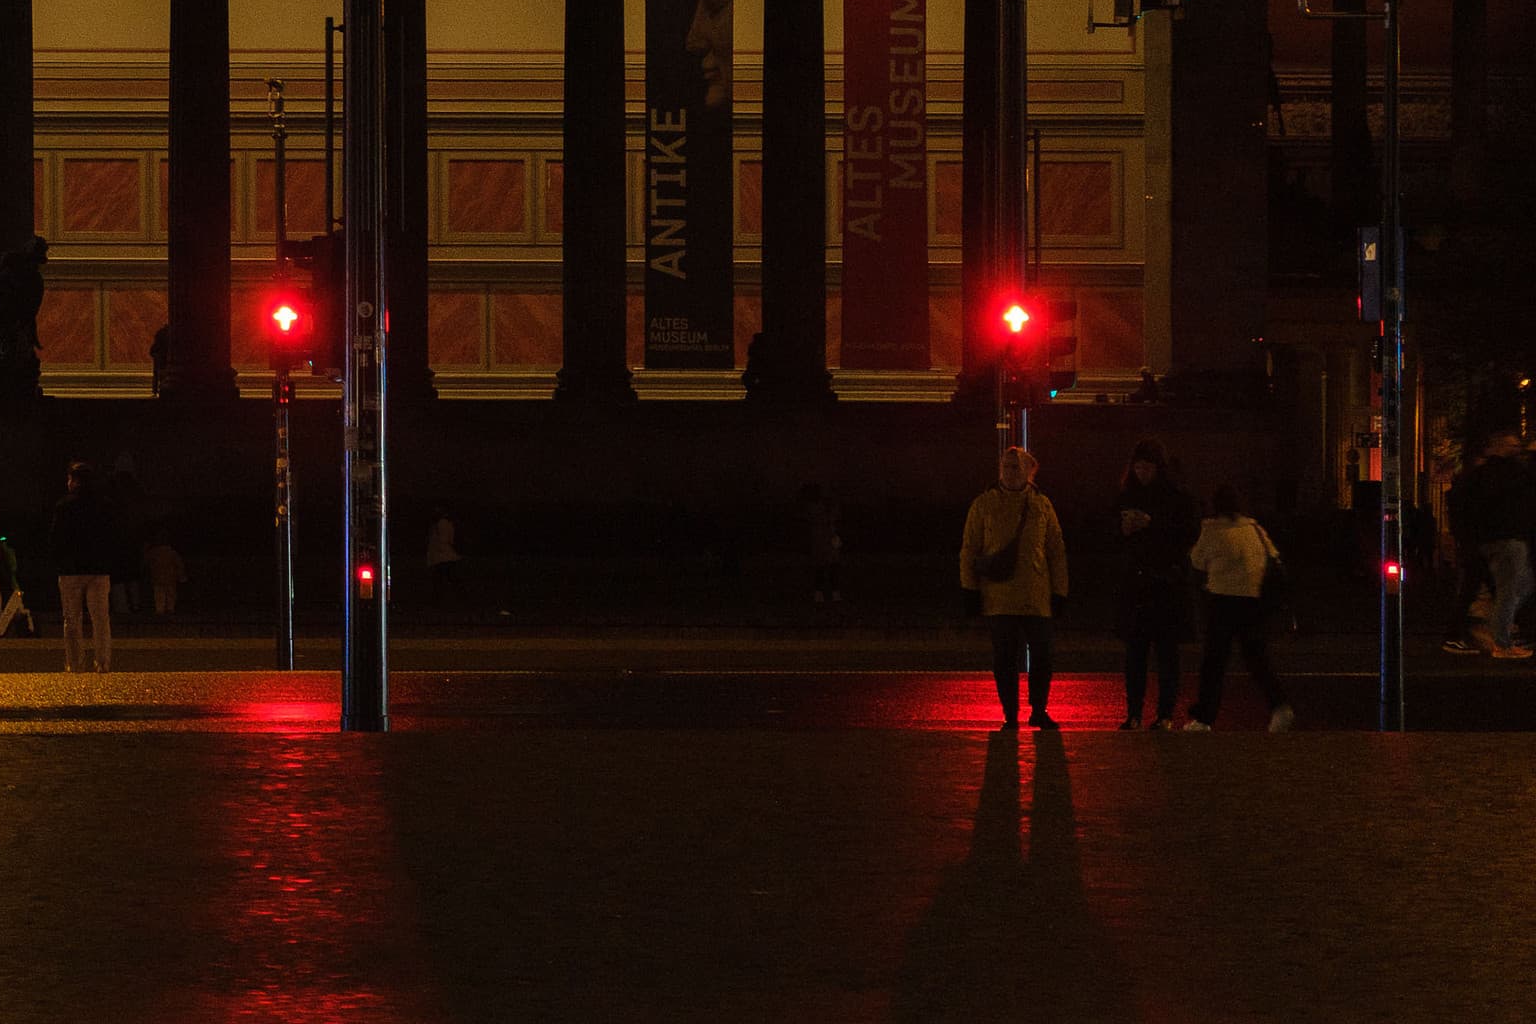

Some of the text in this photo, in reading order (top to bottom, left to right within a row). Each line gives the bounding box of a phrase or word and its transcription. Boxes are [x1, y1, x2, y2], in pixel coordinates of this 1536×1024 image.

[650, 106, 688, 280] ANTIKE
[847, 104, 884, 242] ALTES
[650, 317, 689, 330] ALTES
[650, 331, 709, 344] MUSEUM
